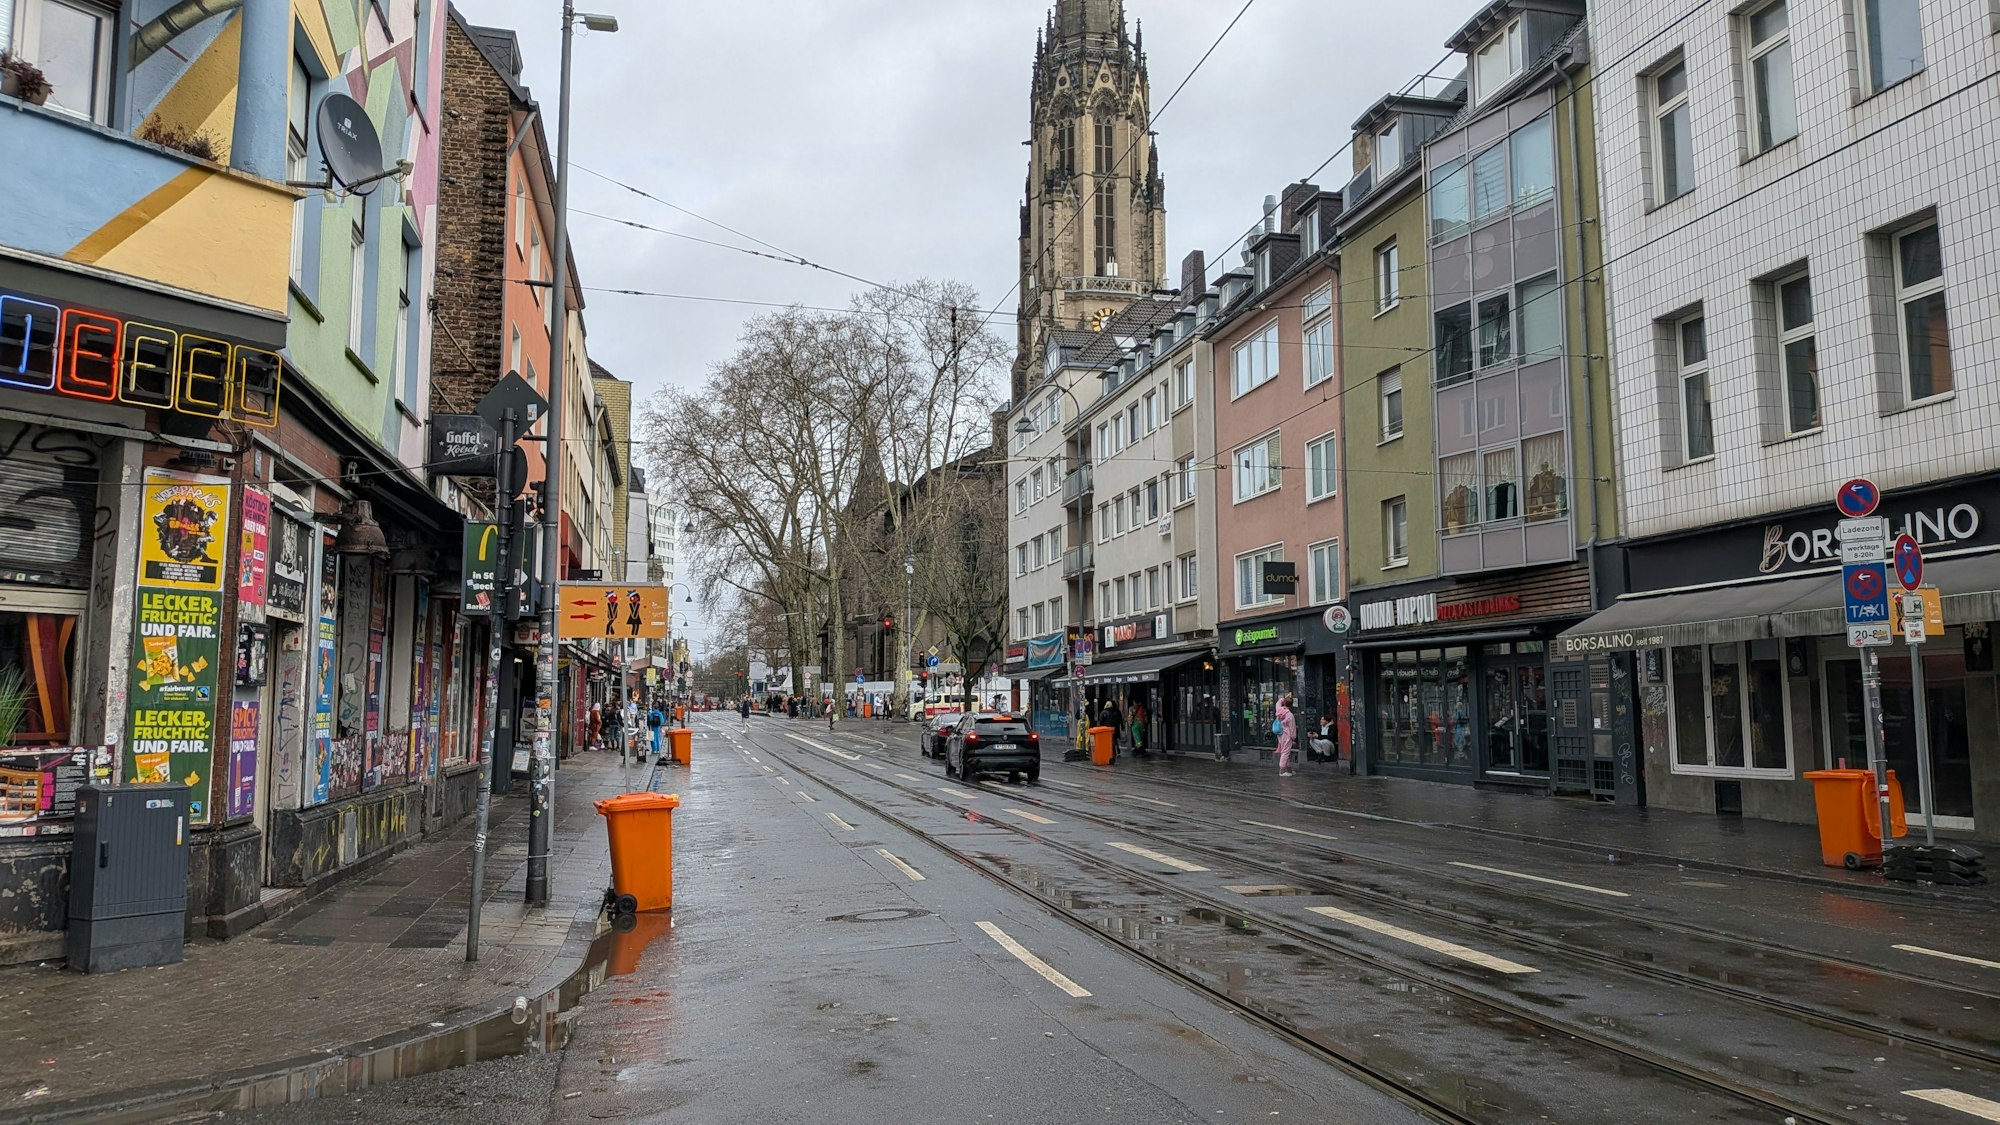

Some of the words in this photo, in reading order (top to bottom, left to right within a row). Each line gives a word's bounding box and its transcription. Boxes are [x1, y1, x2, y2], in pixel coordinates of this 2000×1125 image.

[337, 122, 358, 141] TRIAX
[446, 430, 481, 445] Gaffel
[1842, 525, 1880, 534] Ladezone
[1759, 503, 1980, 574] BORLINO
[1847, 544, 1880, 552] werktags
[1853, 551, 1874, 559] 8-20h
[1266, 573, 1295, 583] duma
[142, 593, 218, 614] LECKER,
[1457, 600, 1485, 619] PASTA
[1849, 603, 1885, 618] TAXI
[141, 610, 217, 625] FRUCHTIG.
[1360, 600, 1395, 630] NONNA
[1396, 593, 1437, 626] NAPOLI
[141, 623, 176, 637] UND
[177, 625, 216, 639] FAIR.
[1069, 633, 1094, 641] MAGO
[1566, 633, 1634, 652] BORSALINO
[1648, 636, 1664, 645] 1987
[135, 710, 211, 728] LECKER,
[133, 727, 209, 740] FRUCHTIG.
[133, 739, 169, 753] UND
[170, 739, 209, 753] FAIR.
